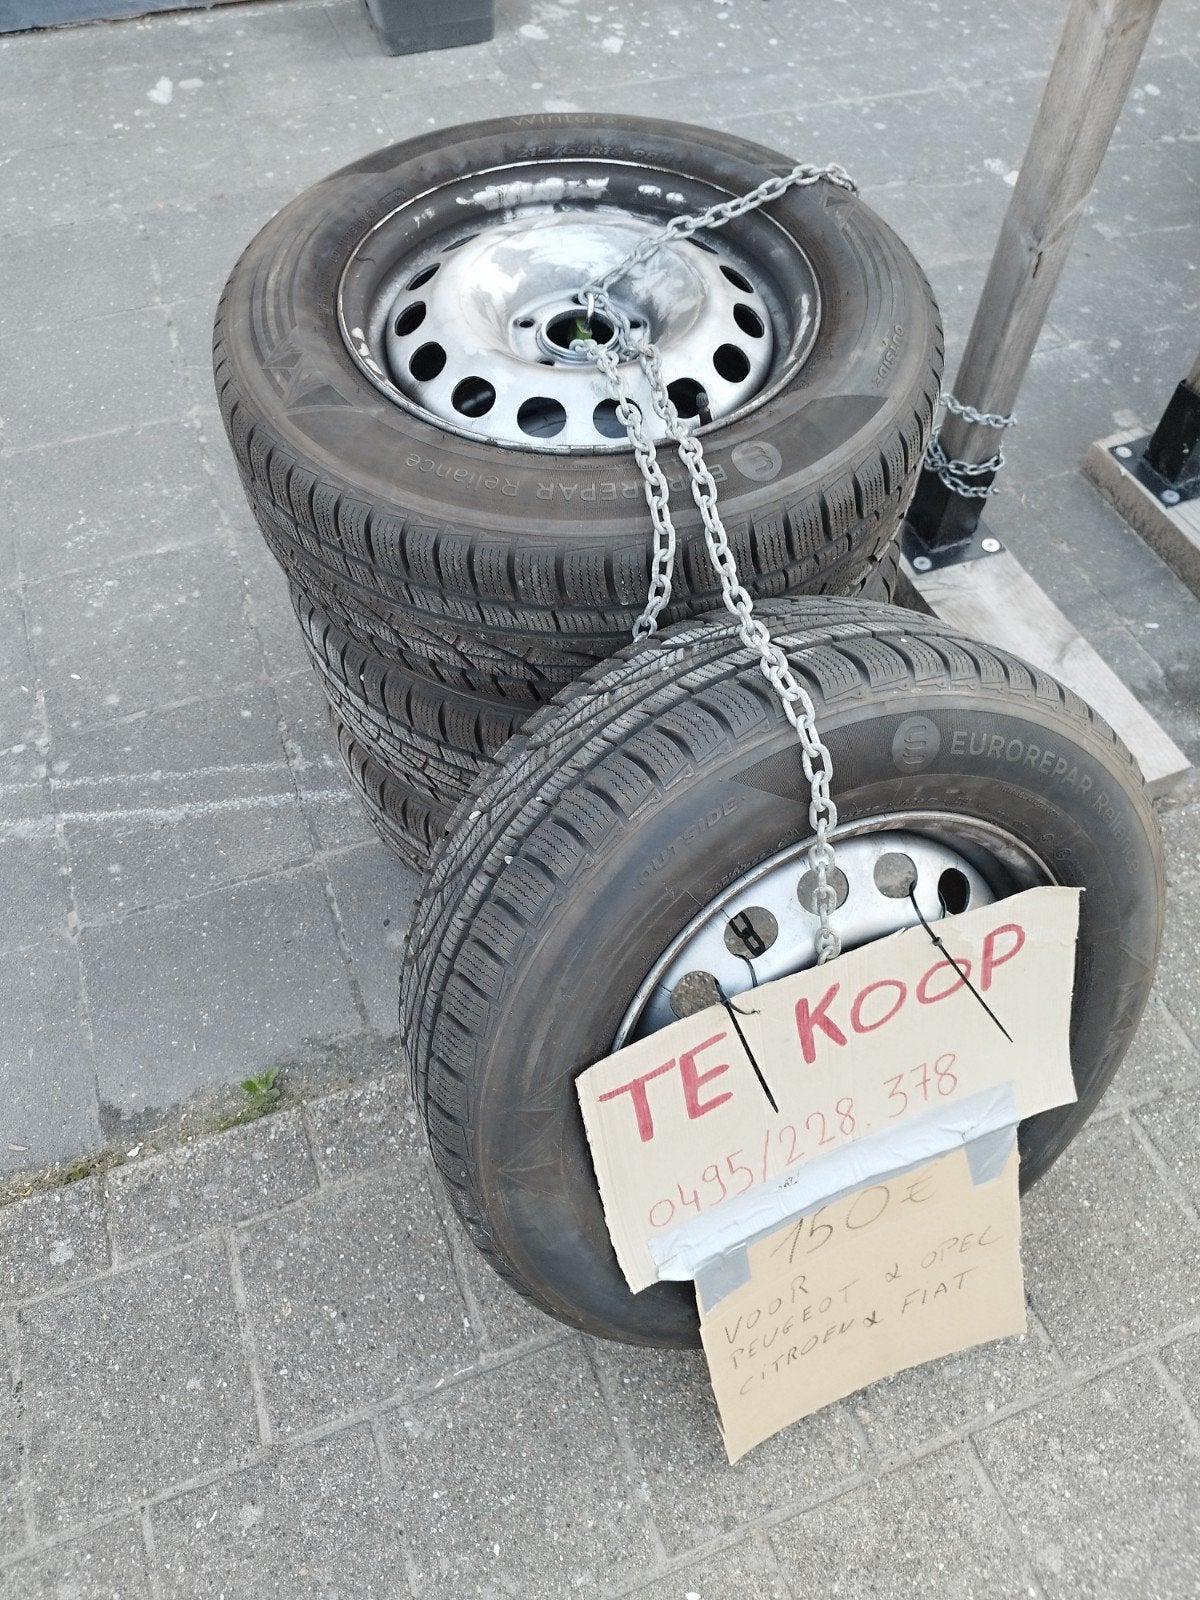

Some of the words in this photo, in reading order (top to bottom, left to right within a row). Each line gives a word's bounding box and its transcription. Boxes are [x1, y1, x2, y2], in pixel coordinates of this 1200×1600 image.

[872, 324, 906, 389] OUTSIDE
[405, 452, 521, 498] Reliance
[637, 795, 740, 886] OUTSIDE
[950, 730, 1092, 795] EUROREPAR
[1091, 786, 1142, 874] Reliance
[598, 1031, 734, 1143] TE
[794, 922, 1026, 1064] KOOP
[724, 1275, 809, 1345] VOOR
[729, 1279, 861, 1369] PEUGEOT
[920, 1225, 1004, 1269] OPEL
